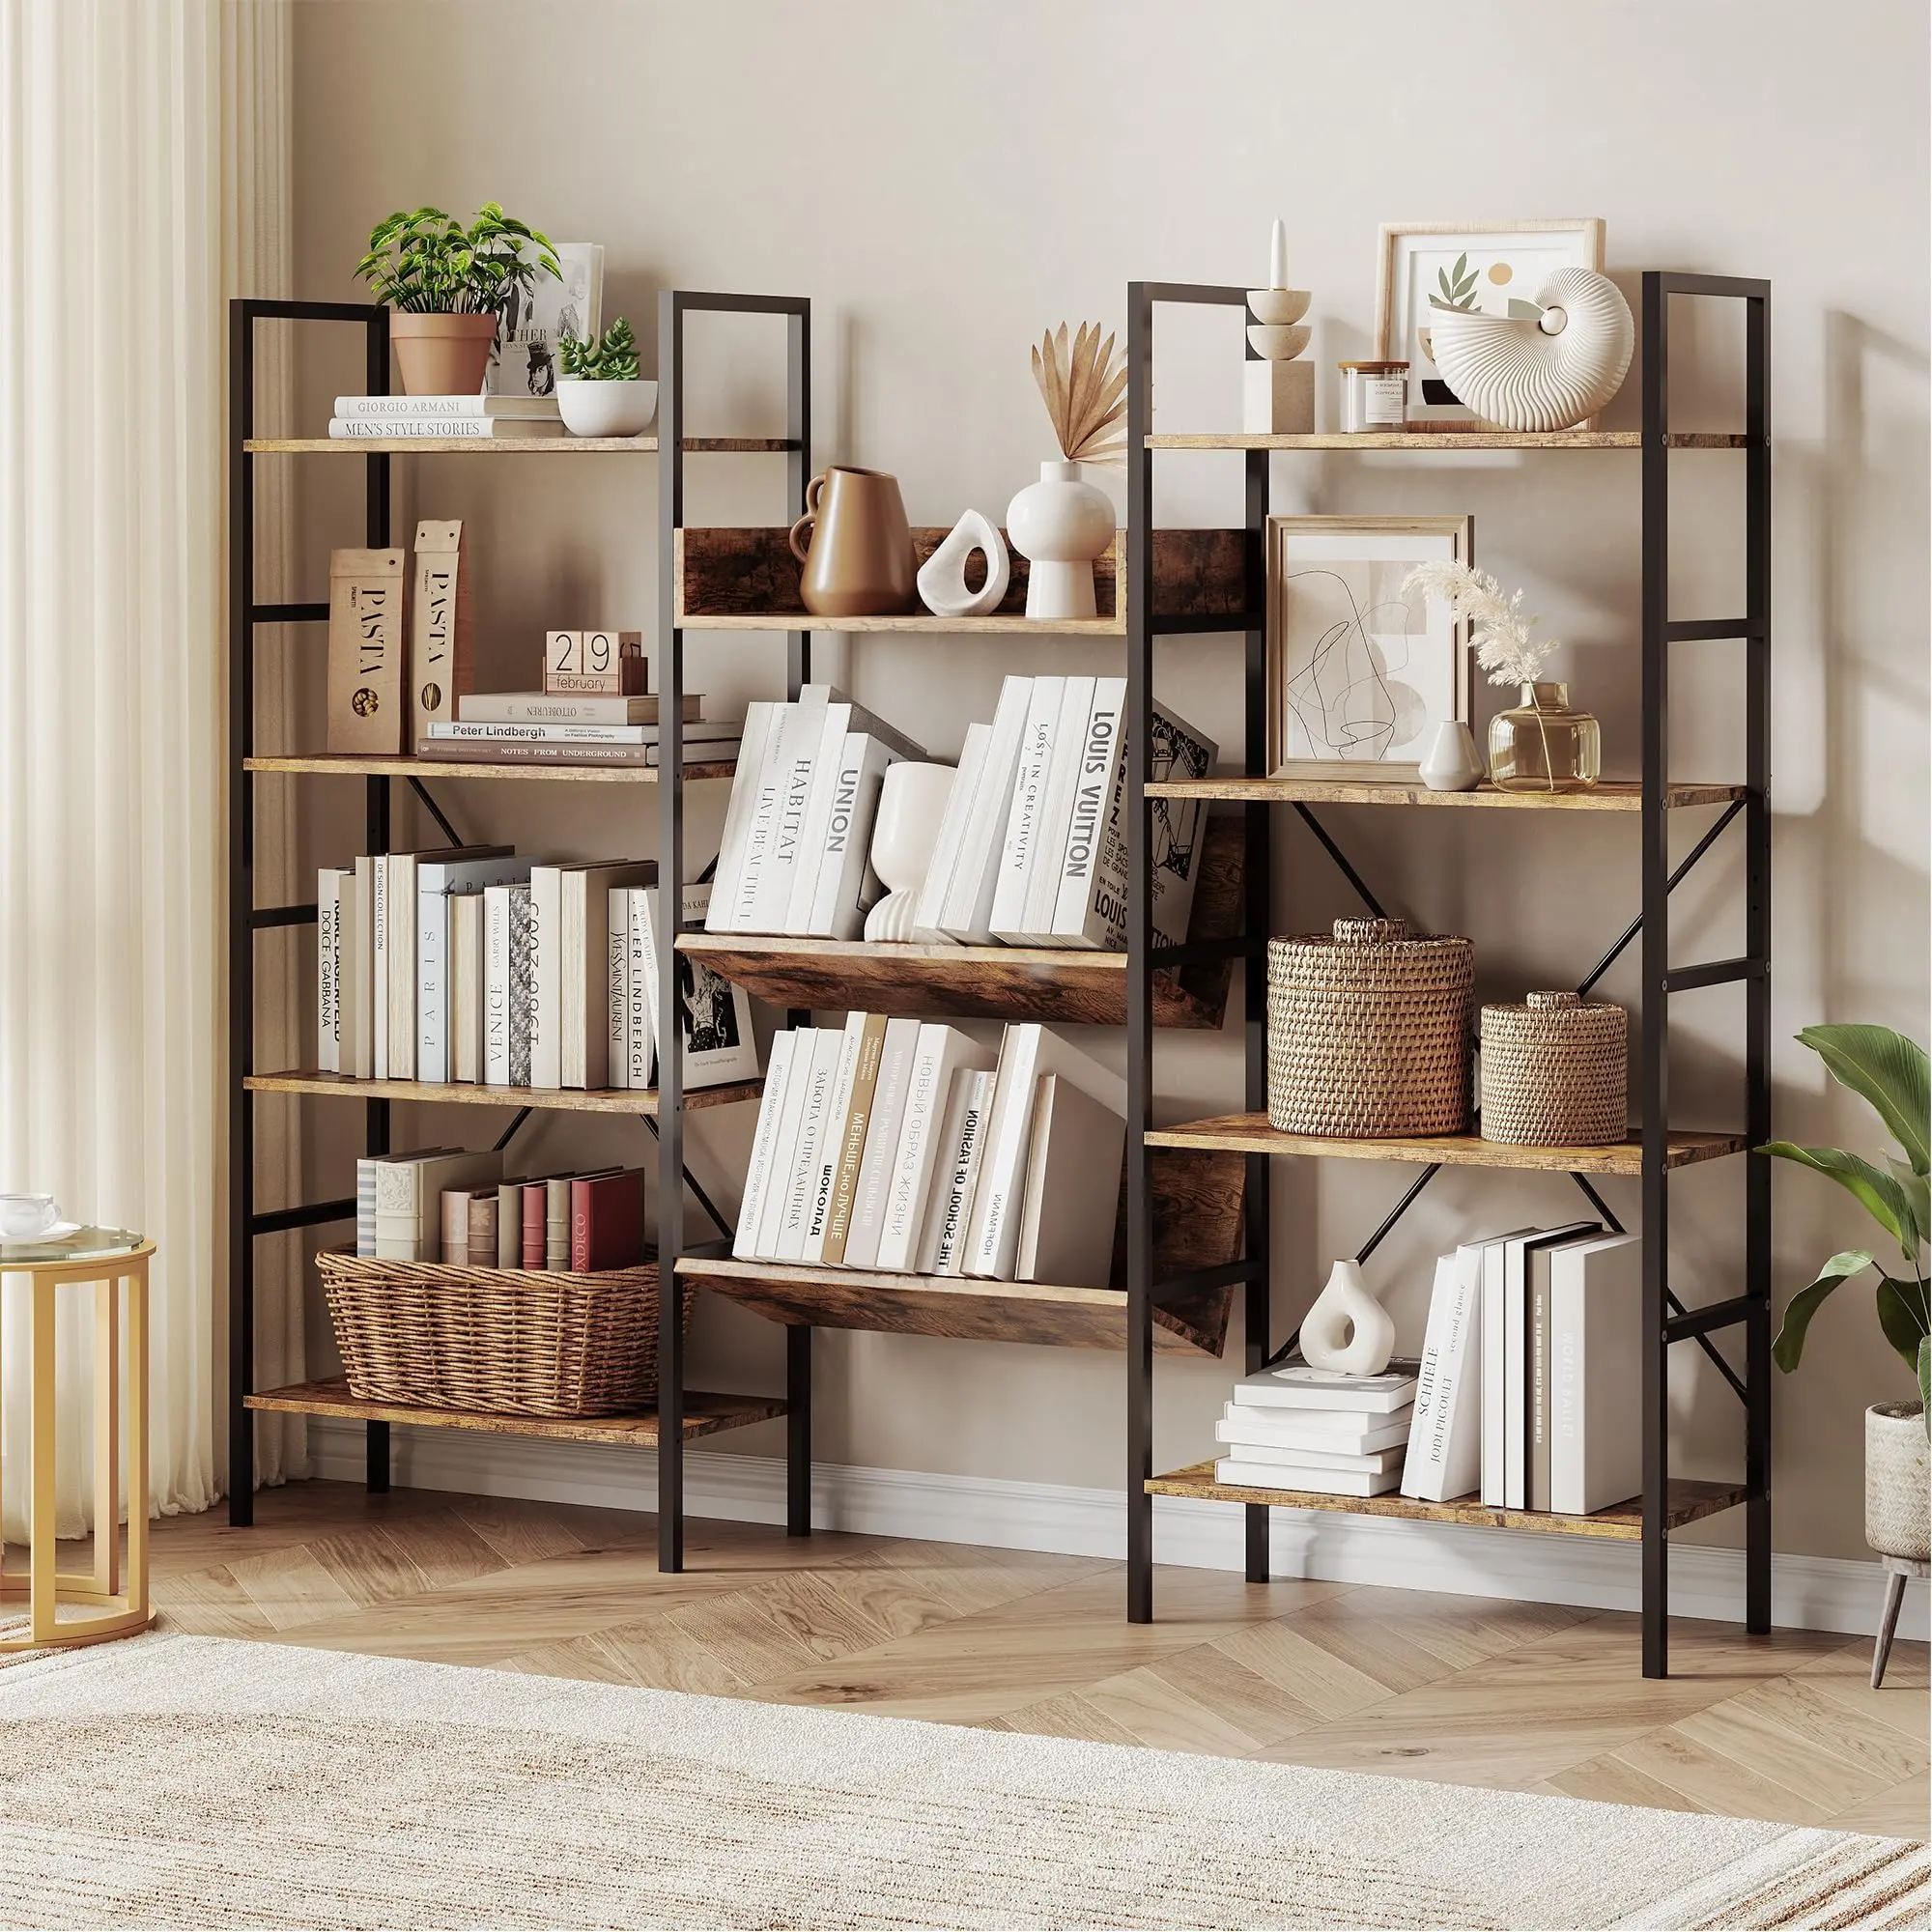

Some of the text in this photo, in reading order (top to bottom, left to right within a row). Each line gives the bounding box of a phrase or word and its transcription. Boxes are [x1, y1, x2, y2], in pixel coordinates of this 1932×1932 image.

[346, 422, 480, 436] MEN'S STYLE STORIES
[358, 402, 460, 412] GIORGIO ARMANI
[359, 589, 385, 674] PASTA
[428, 573, 449, 664] PASTA
[556, 674, 606, 691] february
[452, 724, 546, 739] Peter Lindbergh
[526, 706, 578, 718] OTTOBEUREN
[500, 748, 529, 756] NOTES
[562, 750, 627, 758] UNDERGROUND
[1031, 764, 1041, 779] IN
[758, 786, 776, 827] LIVE
[778, 758, 811, 864] HABITAT
[827, 769, 858, 853] UNION
[1066, 711, 1115, 878] LOUIS VUITTON
[1014, 784, 1037, 869] CREATIVITY
[1105, 845, 1114, 858] LES
[1106, 836, 1128, 856] LES SPO
[1099, 875, 1106, 886] EN
[321, 910, 331, 952] DOLCE
[1094, 889, 1128, 930] LOUIS
[493, 938, 501, 967] GARRY
[321, 961, 331, 1028] GABBANA
[424, 930, 436, 1047] PARIS
[490, 983, 503, 1062] VENICE
[632, 969, 642, 1078] LINDBERGH
[788, 1068, 828, 1230] ЗАБОТА О ПРЕДАННЫХ
[891, 1055, 935, 1236] НОВЫЙ ОБРАЗ ЖИЗНИ
[810, 1164, 833, 1236] ШОКОЛАД
[831, 1192, 850, 1240] ЛУЧШЕ
[1418, 1346, 1439, 1416] SCHIELE
[1431, 1283, 1466, 1463] JODI PICOULT second glance
